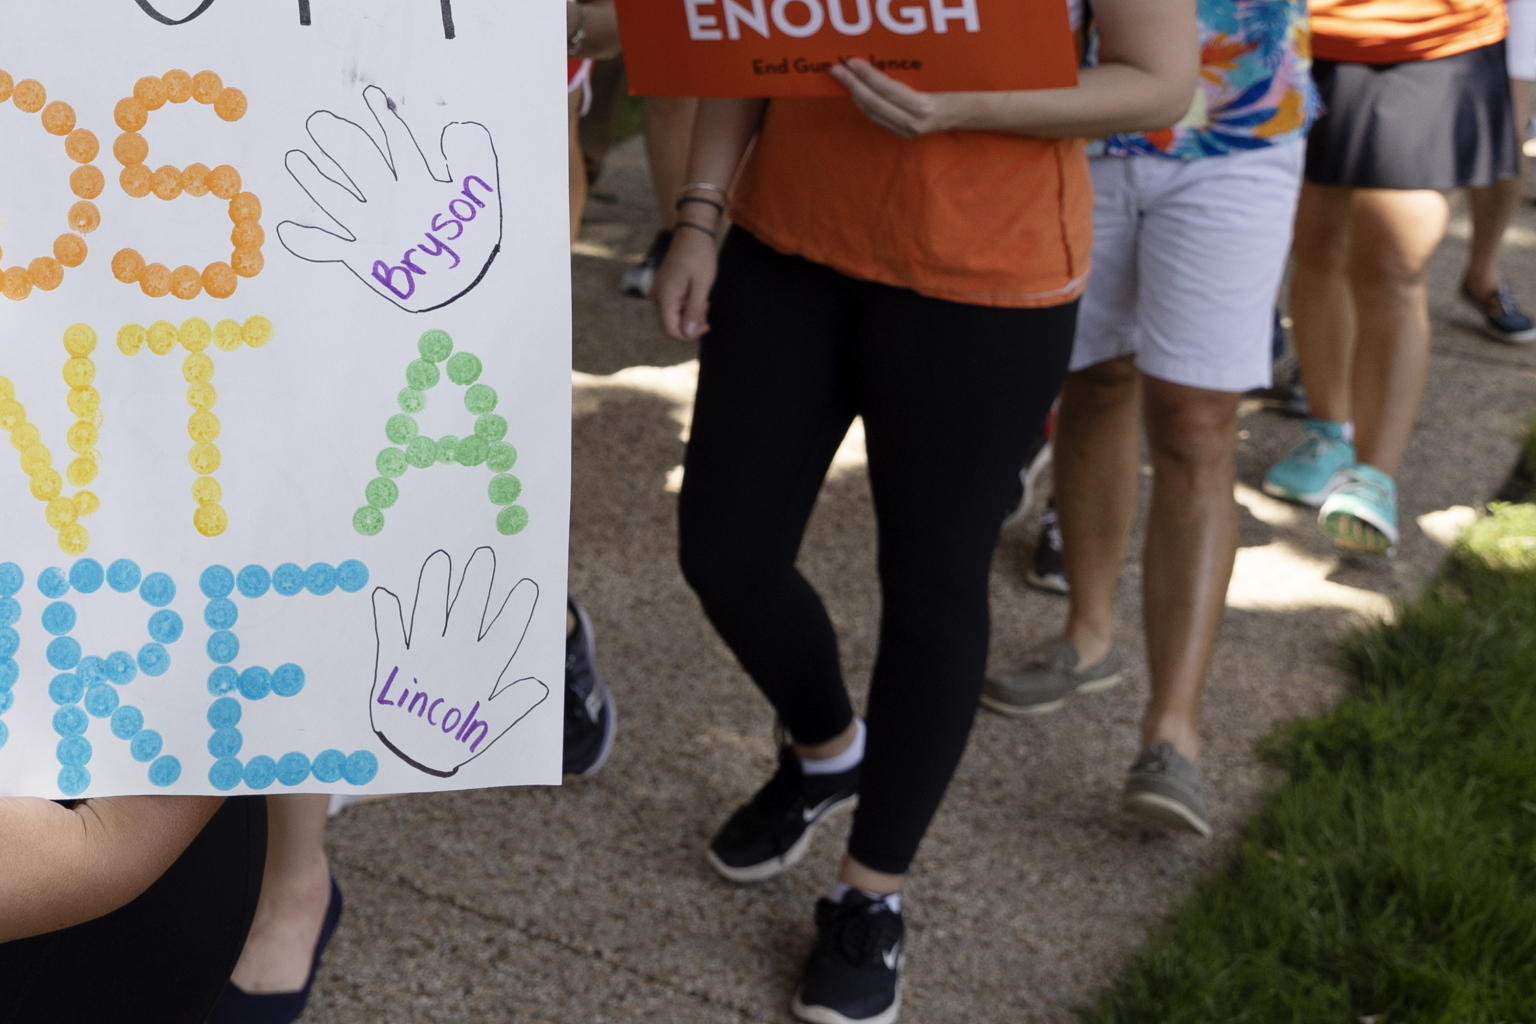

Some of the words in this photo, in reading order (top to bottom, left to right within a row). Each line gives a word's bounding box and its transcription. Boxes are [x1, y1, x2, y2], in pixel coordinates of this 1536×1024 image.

[371, 175, 494, 300] Bryson
[352, 328, 528, 536] A
[376, 665, 489, 754] Lincoln
